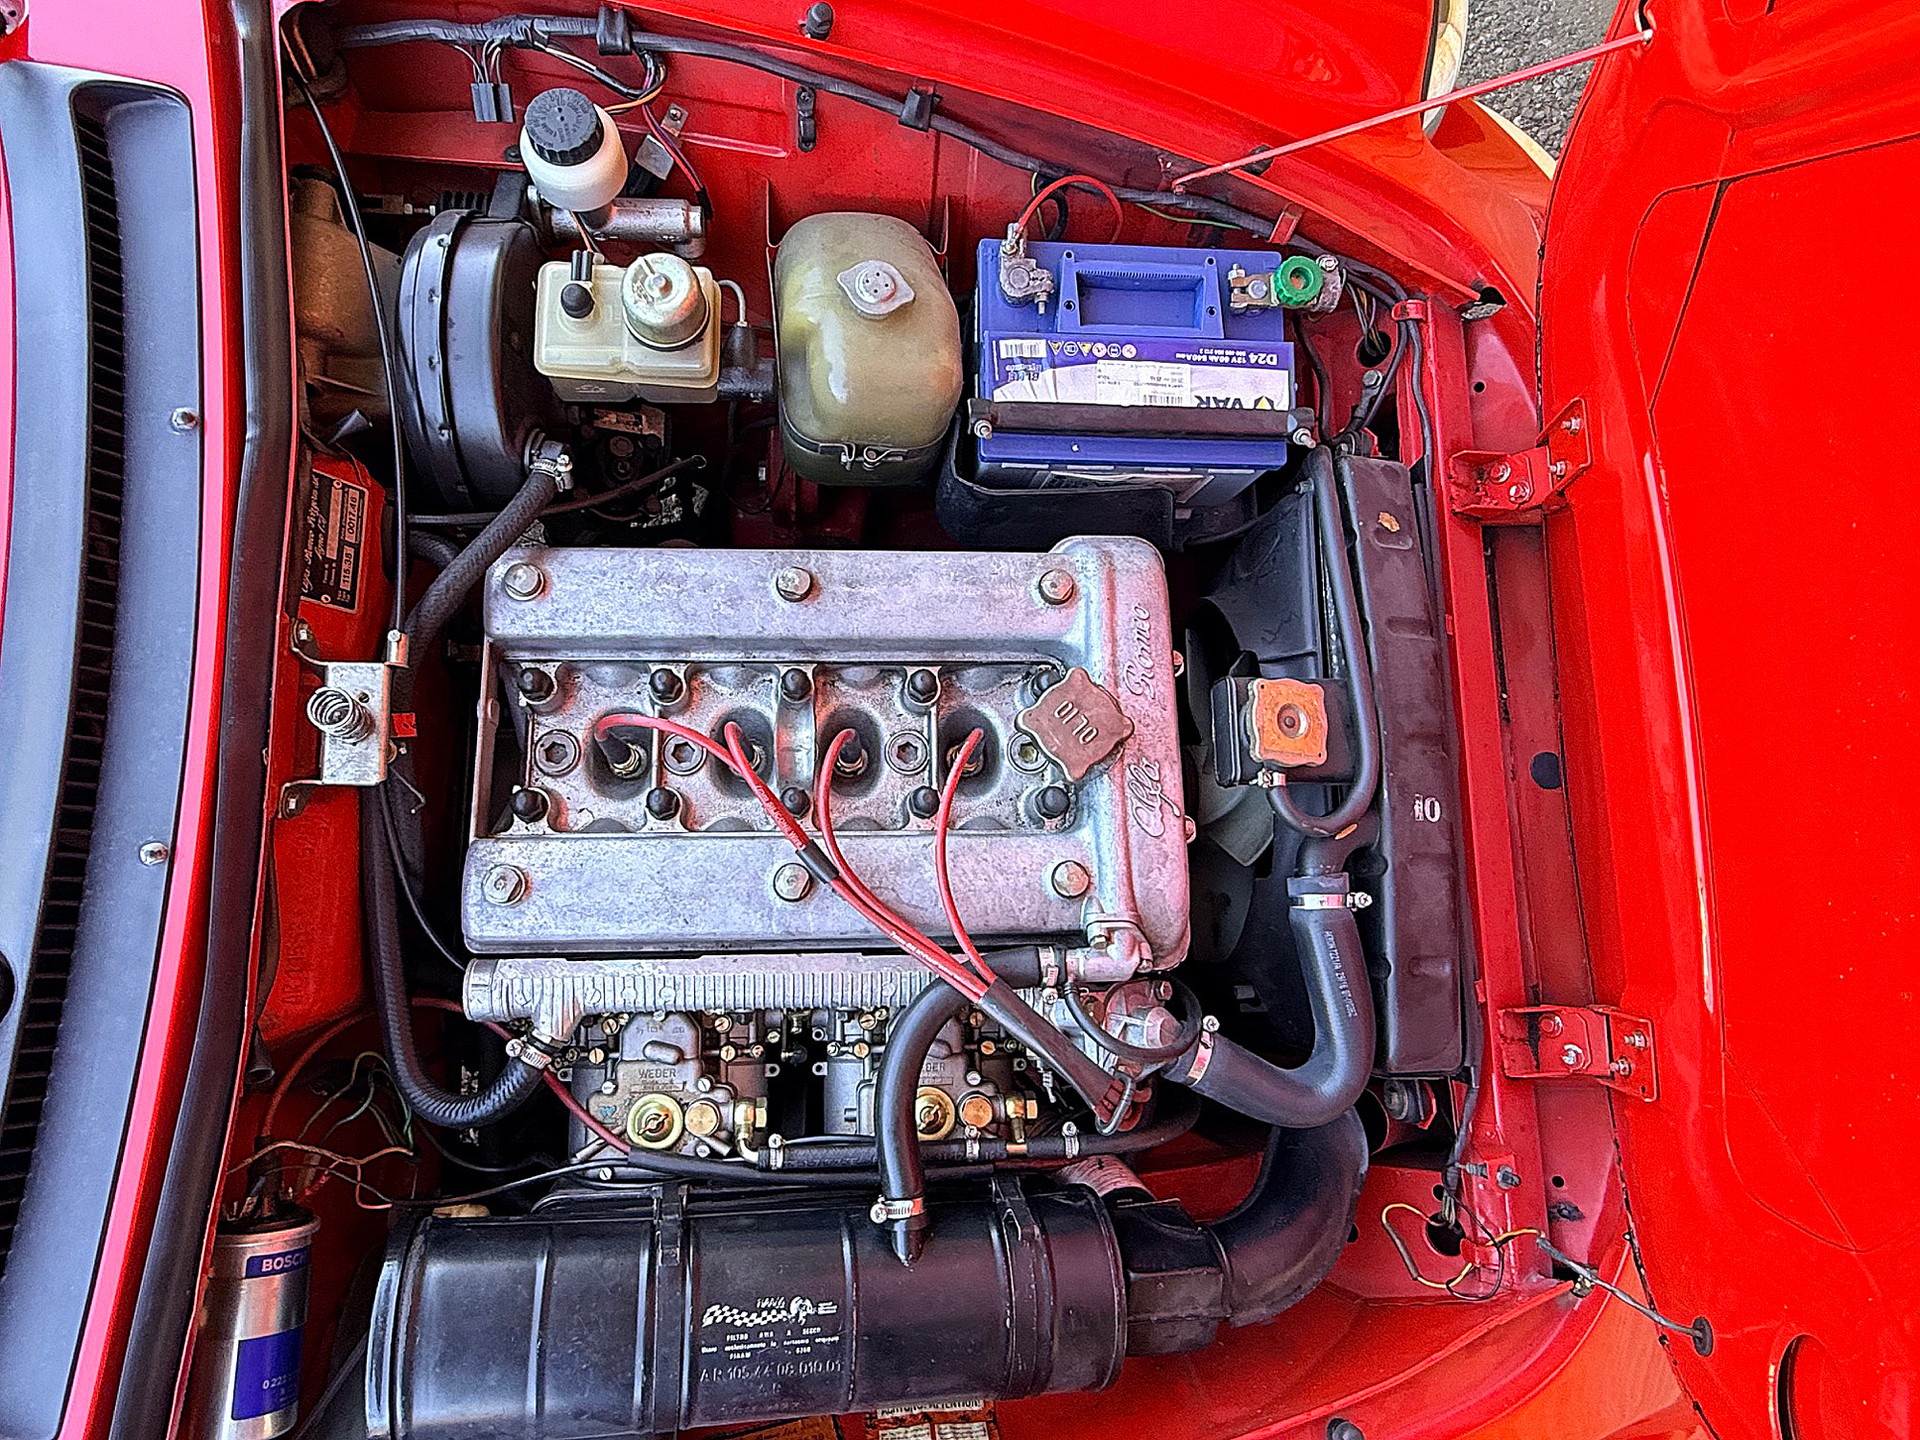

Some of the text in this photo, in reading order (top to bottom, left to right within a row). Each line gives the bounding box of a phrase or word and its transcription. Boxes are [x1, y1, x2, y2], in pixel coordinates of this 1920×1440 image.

[1249, 353, 1278, 365] D24
[1194, 395, 1244, 409] VAR
[1053, 700, 1099, 745] OLIO
[1123, 603, 1181, 838] Alfa Romeo
